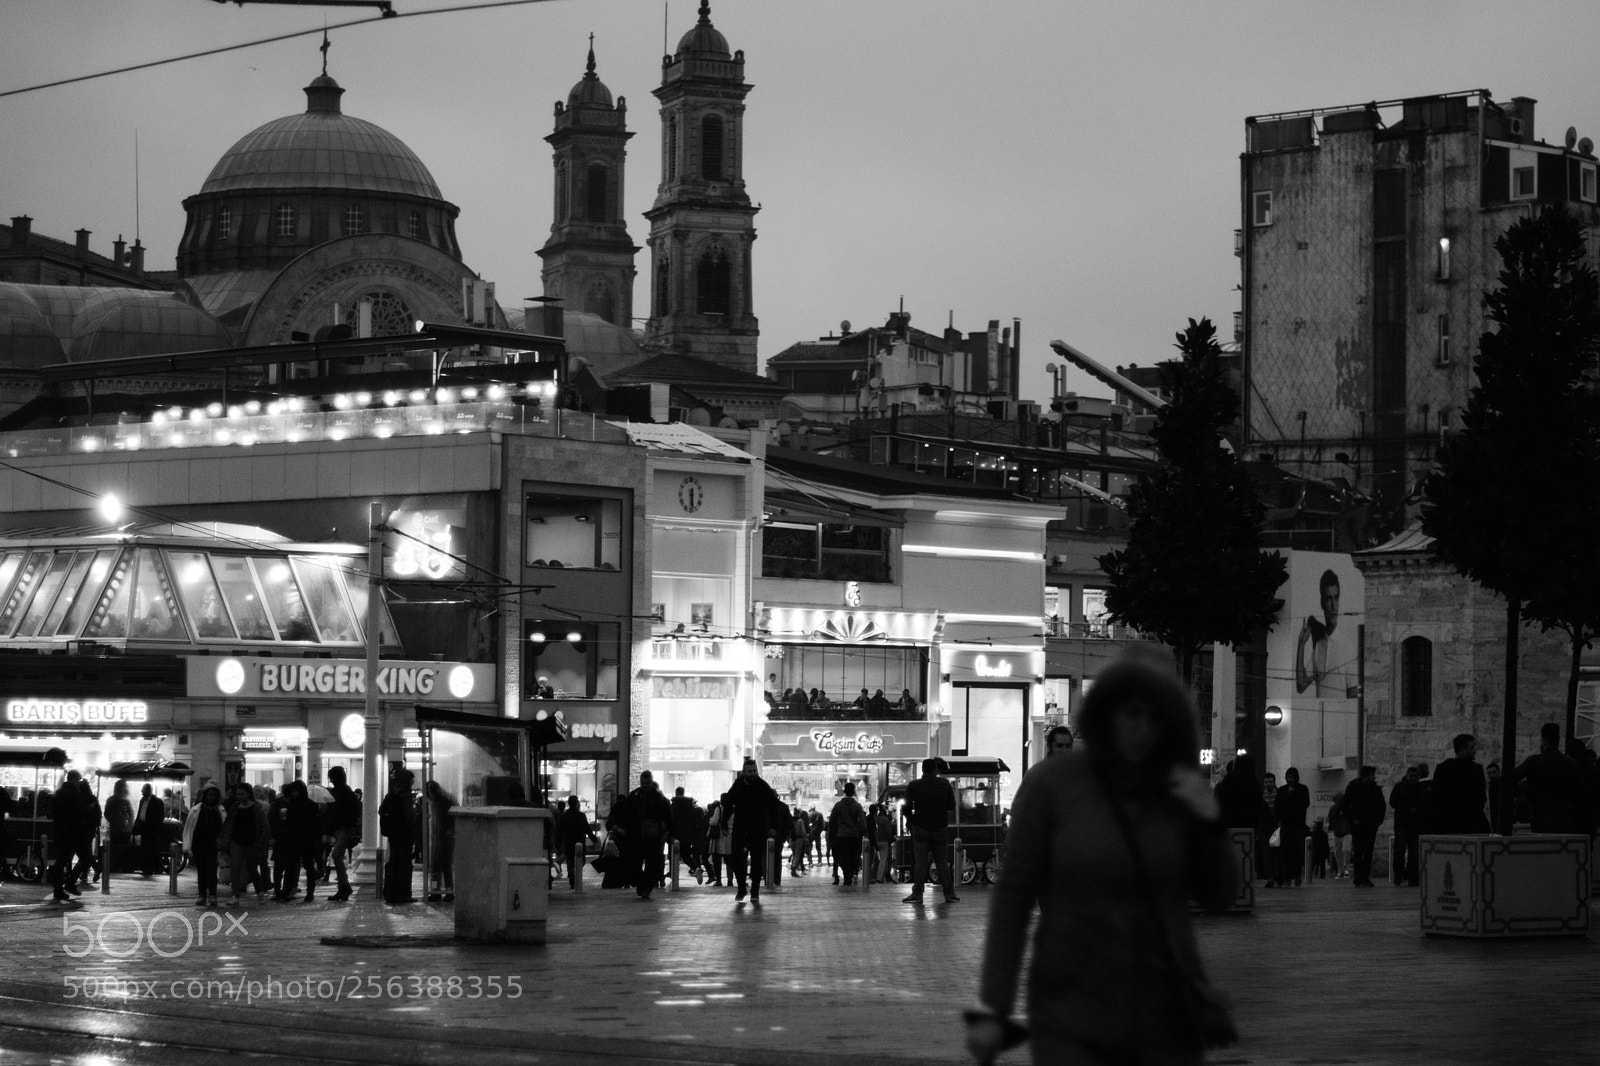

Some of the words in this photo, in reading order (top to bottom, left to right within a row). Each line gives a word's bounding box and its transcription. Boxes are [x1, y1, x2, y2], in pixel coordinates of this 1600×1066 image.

[261, 664, 366, 693] BURGER
[376, 667, 434, 695] KING
[10, 703, 80, 724] BARIŞ
[86, 702, 147, 722] BÜFE
[813, 731, 856, 756] Taksim
